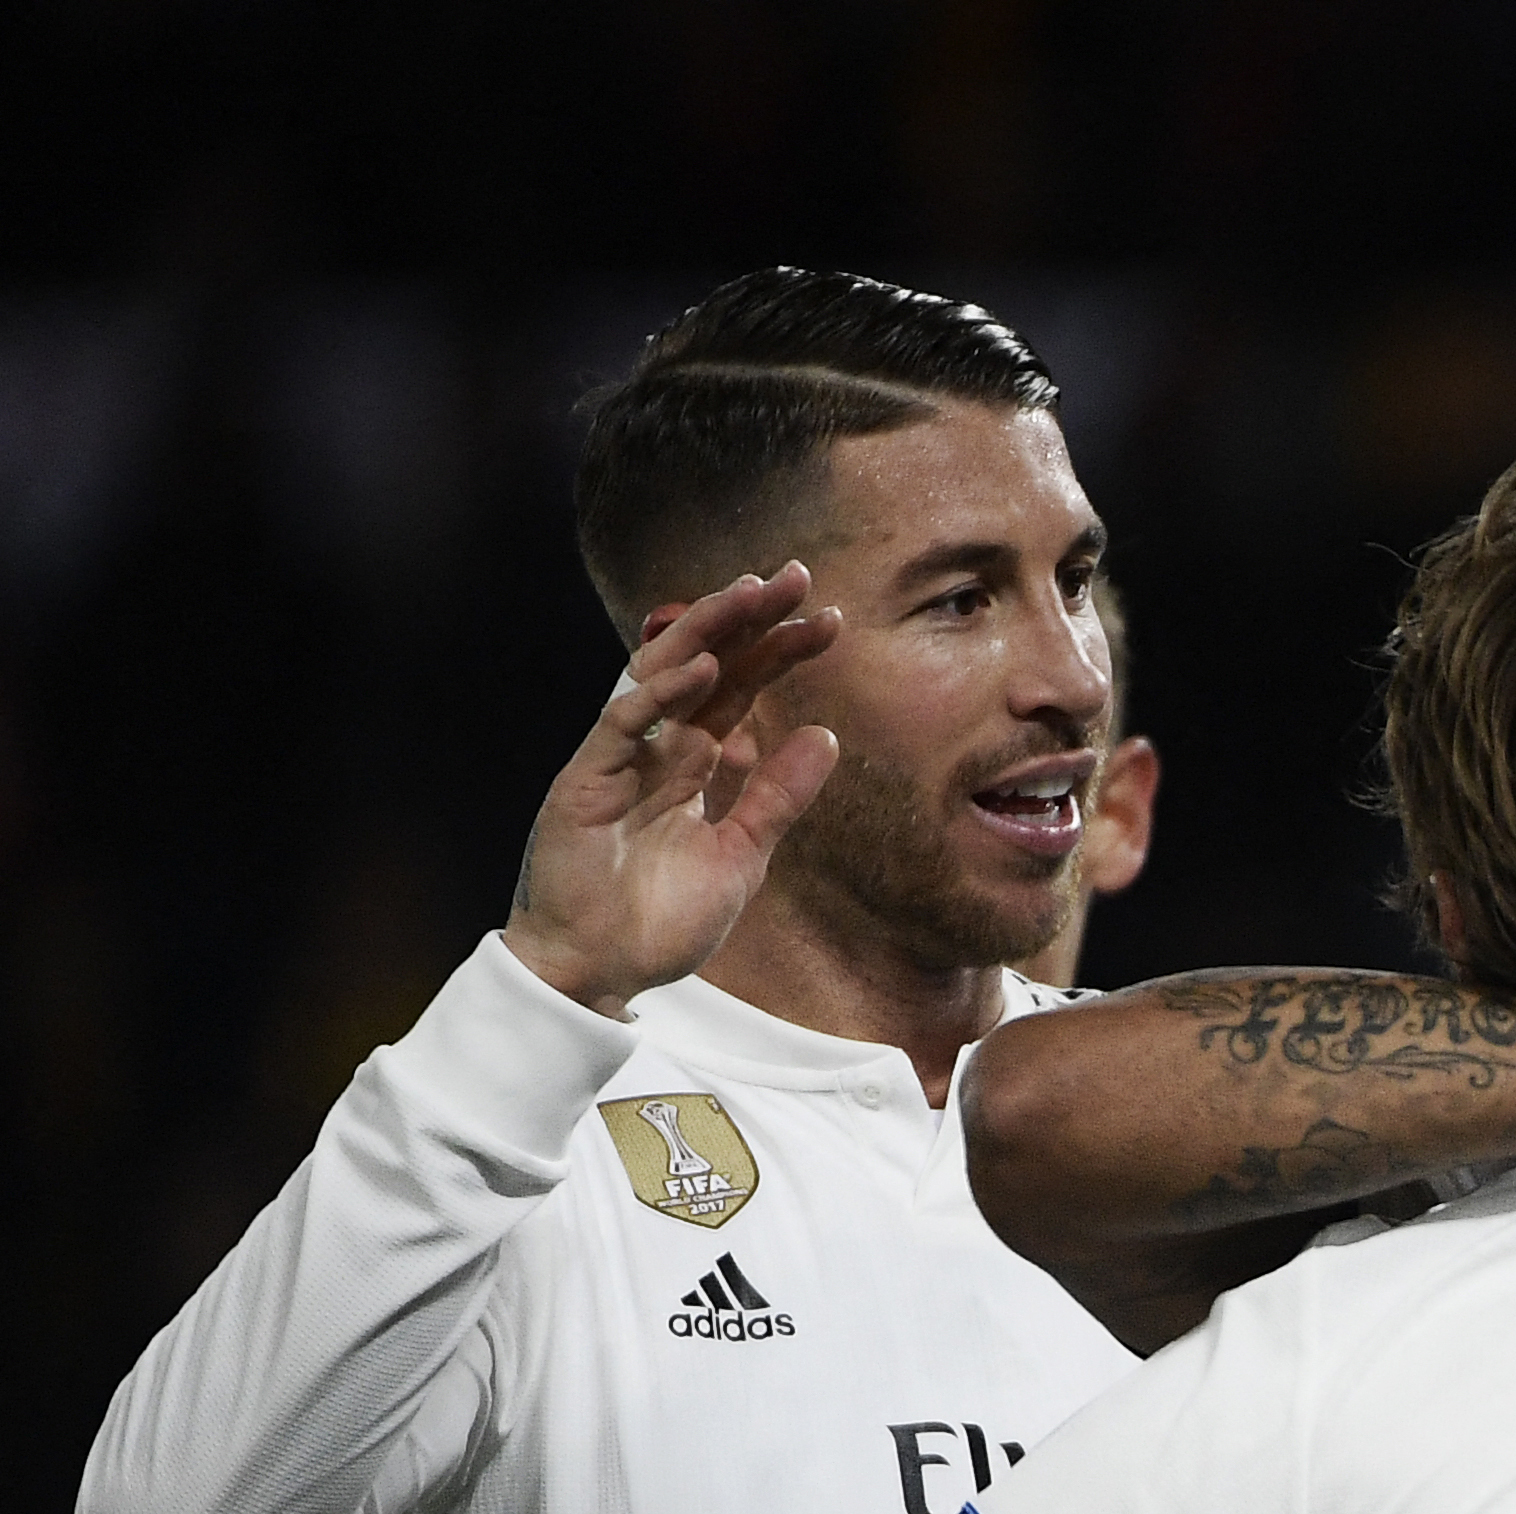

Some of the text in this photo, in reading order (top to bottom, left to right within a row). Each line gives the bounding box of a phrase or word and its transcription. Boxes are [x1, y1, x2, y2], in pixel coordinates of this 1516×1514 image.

[664, 1173, 731, 1198] FIFA
[688, 1199, 725, 1215] 2017
[668, 1309, 796, 1342] adidas
